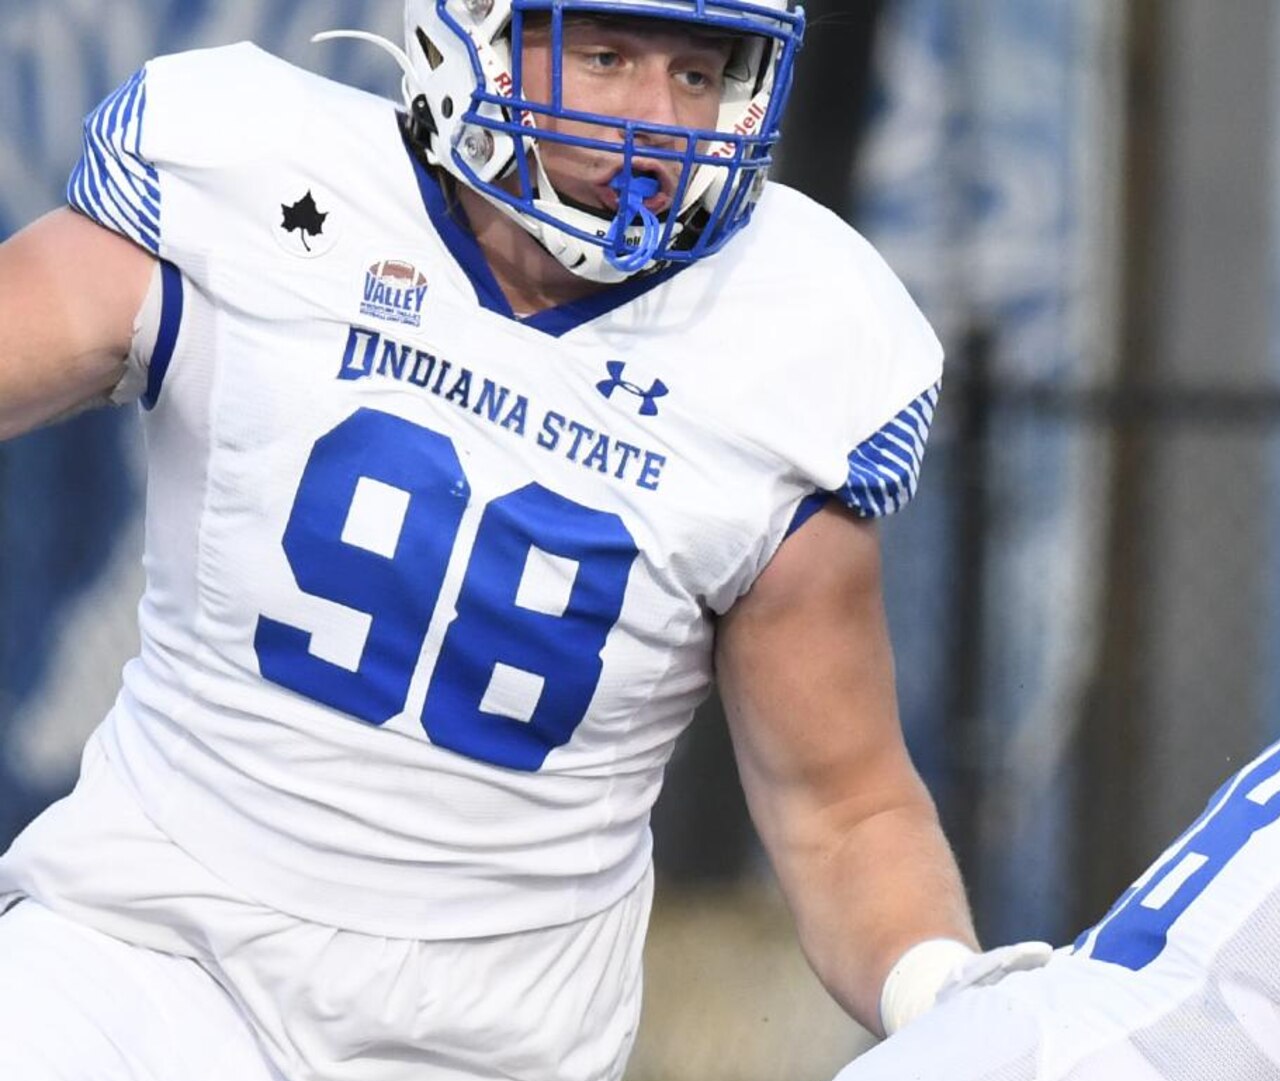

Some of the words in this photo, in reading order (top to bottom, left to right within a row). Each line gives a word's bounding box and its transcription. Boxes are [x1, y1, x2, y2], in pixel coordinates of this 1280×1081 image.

[364, 270, 428, 313] VALLEY
[336, 325, 529, 437] INDIANA
[537, 409, 667, 492] STATE
[253, 407, 640, 772] 98
